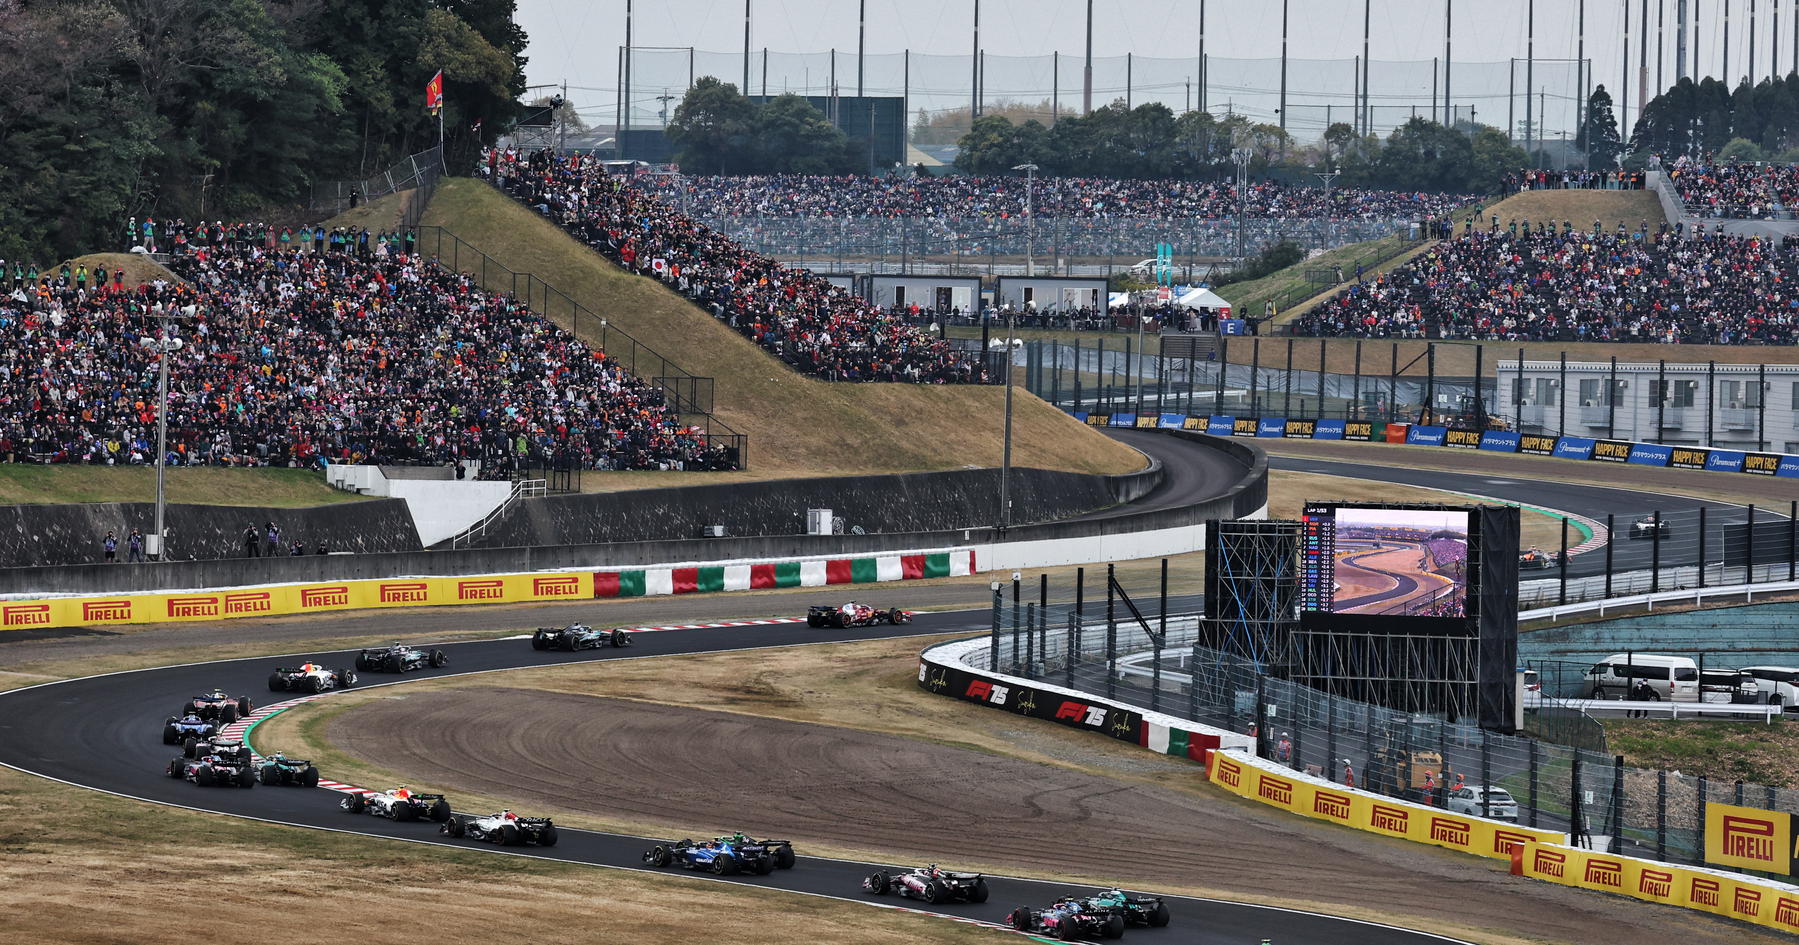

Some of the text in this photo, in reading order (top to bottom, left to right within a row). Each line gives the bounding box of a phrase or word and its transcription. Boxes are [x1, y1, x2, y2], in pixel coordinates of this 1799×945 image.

[1227, 322, 1234, 334] E
[1184, 418, 1208, 430] HAPPY FACE
[1234, 420, 1256, 432] HAPPY FACE
[1260, 422, 1284, 433] Paramount+
[1286, 421, 1313, 434] HAPPY FACE
[1346, 423, 1372, 436] HAPPY FACE
[1410, 430, 1442, 442] Paramount+
[1447, 431, 1480, 444] HAPPY FACE
[1522, 437, 1554, 450] HAPPY FACE
[1558, 442, 1591, 453] Paramount+
[1595, 443, 1629, 457] HAPPY FACE
[1632, 451, 1666, 460] パラマウントプラス
[1673, 450, 1705, 464] HAPPY FACE
[1710, 454, 1741, 466] Paramount+
[1746, 456, 1777, 470] HAPPY FACE
[301, 586, 348, 607] PIRELLI
[380, 584, 428, 602] PIRELLI
[458, 580, 503, 600] PIRELLI
[534, 577, 578, 596] PIRELLI
[83, 600, 131, 621] PIRELLI
[168, 598, 218, 617] PIRELLI
[225, 592, 270, 613] PIRELLI
[3, 604, 50, 625] PIRELLI
[965, 680, 1010, 705] F1 75
[1055, 702, 1108, 726] F1 75
[1217, 759, 1240, 787] PIRELLI
[1258, 775, 1292, 805] PIRELLI
[1314, 791, 1350, 819] PIRELLI
[1371, 804, 1408, 833] PIRELLI
[1430, 817, 1470, 846] PIRELLI
[1723, 815, 1774, 861] PIRELLI
[1534, 849, 1566, 878] PIRELLI
[1584, 859, 1621, 887] PIRELLI
[1639, 869, 1672, 898] PIRELLI
[1690, 878, 1719, 906] PIRELLI
[1734, 887, 1761, 916] PIRELLI
[1775, 897, 1799, 927] PIRELL
